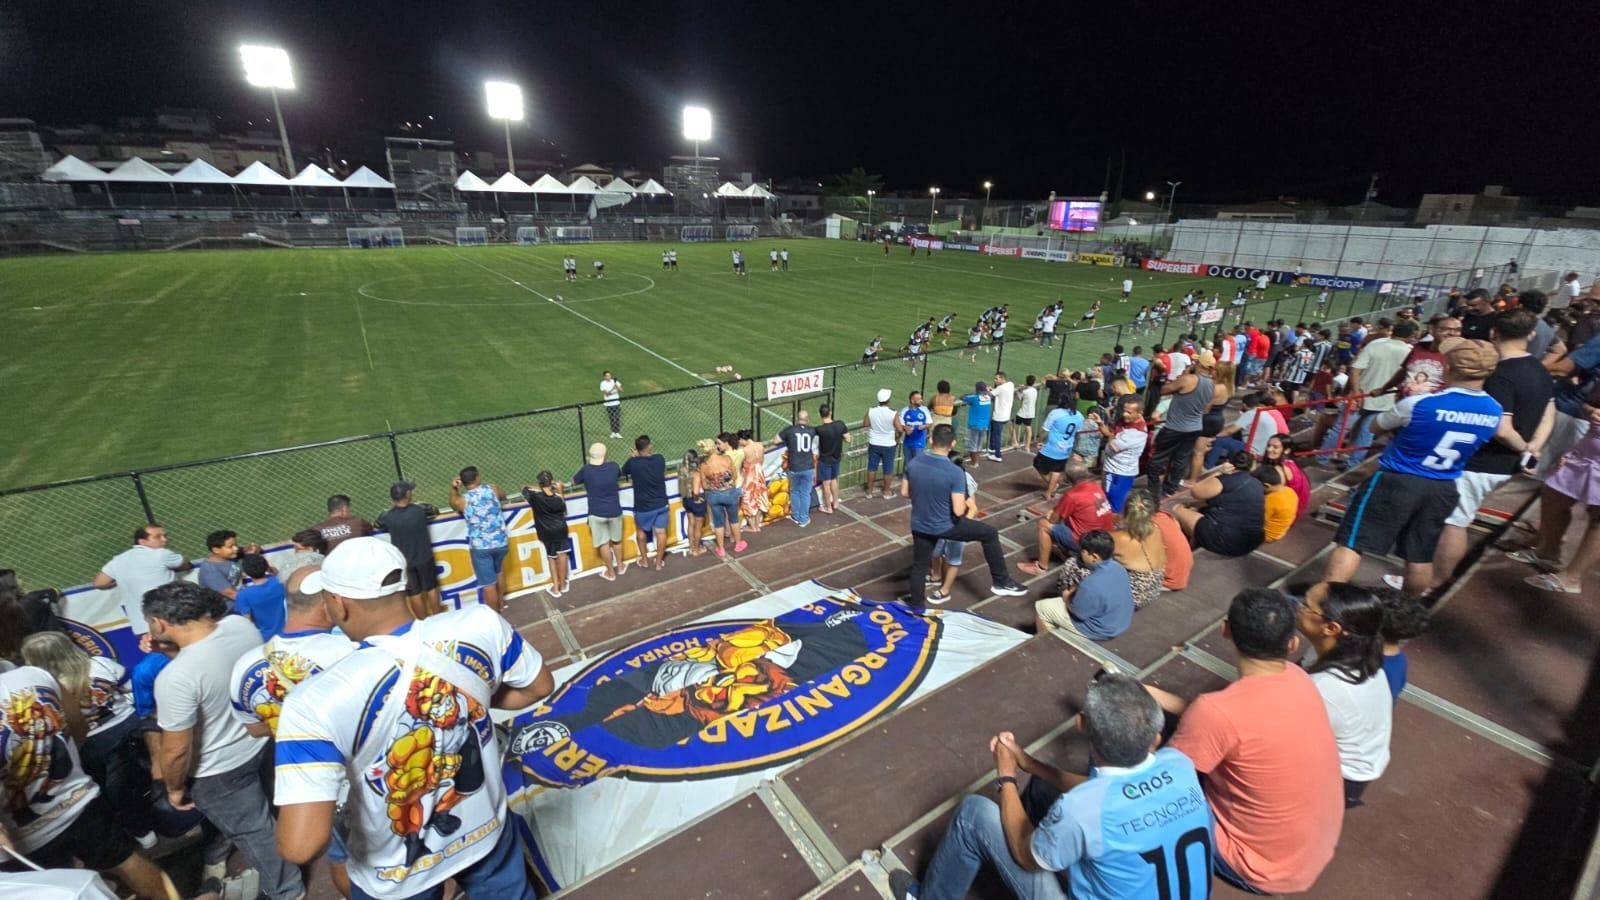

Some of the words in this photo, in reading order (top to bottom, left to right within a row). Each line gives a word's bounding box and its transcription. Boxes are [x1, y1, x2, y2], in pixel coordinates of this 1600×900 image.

[1146, 260, 1200, 273] SUPERBET
[1435, 409, 1500, 428] TONINHO
[795, 432, 811, 453] 10
[1063, 422, 1076, 441] 9
[1421, 430, 1478, 471] 5
[625, 636, 701, 668] HONRA
[1122, 770, 1174, 800] CROS
[1138, 826, 1212, 900] 10
